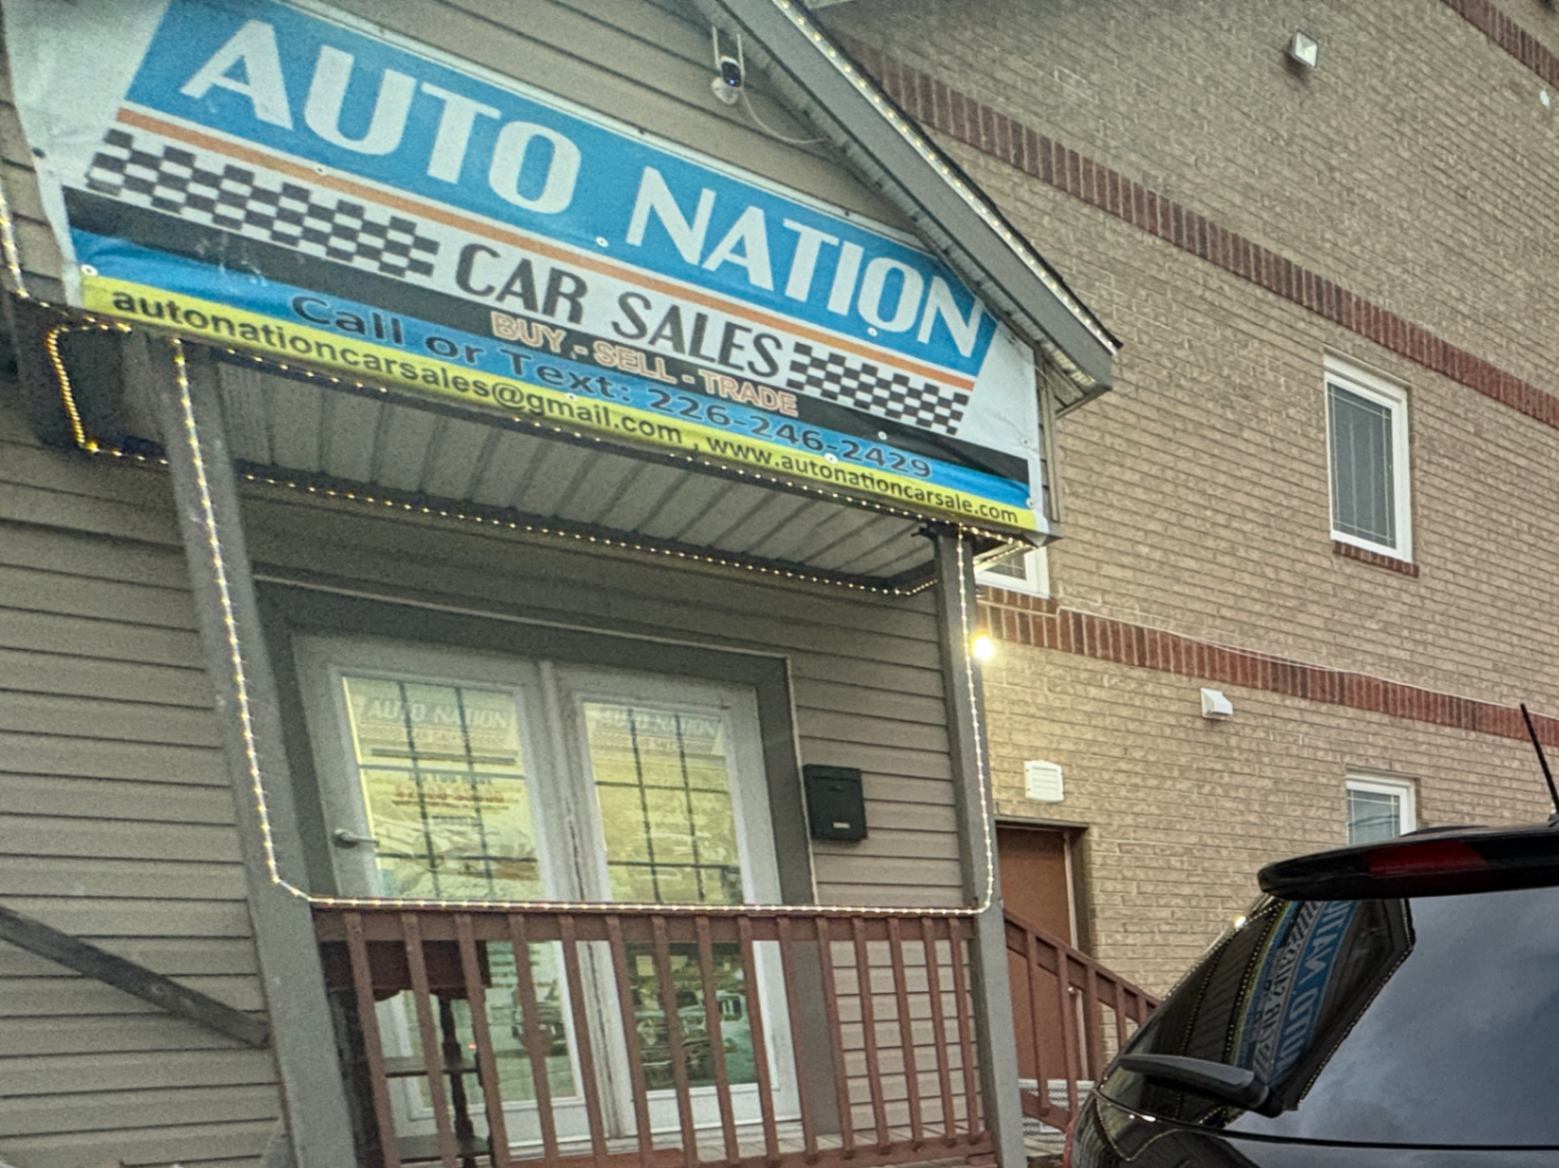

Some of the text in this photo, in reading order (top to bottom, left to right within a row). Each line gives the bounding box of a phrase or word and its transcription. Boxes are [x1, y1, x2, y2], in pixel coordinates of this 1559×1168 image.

[180, 18, 983, 358] AUTO NATION
[291, 295, 931, 480] Call or Text: 226-246-2429
[455, 243, 783, 378] CAR SALES
[490, 311, 566, 353] BUY
[593, 340, 677, 385] SELL
[699, 369, 799, 418] TRADE
[111, 291, 683, 445] autonationcarsales@gmail.com
[706, 436, 1018, 524] www.autonationcarsale.com
